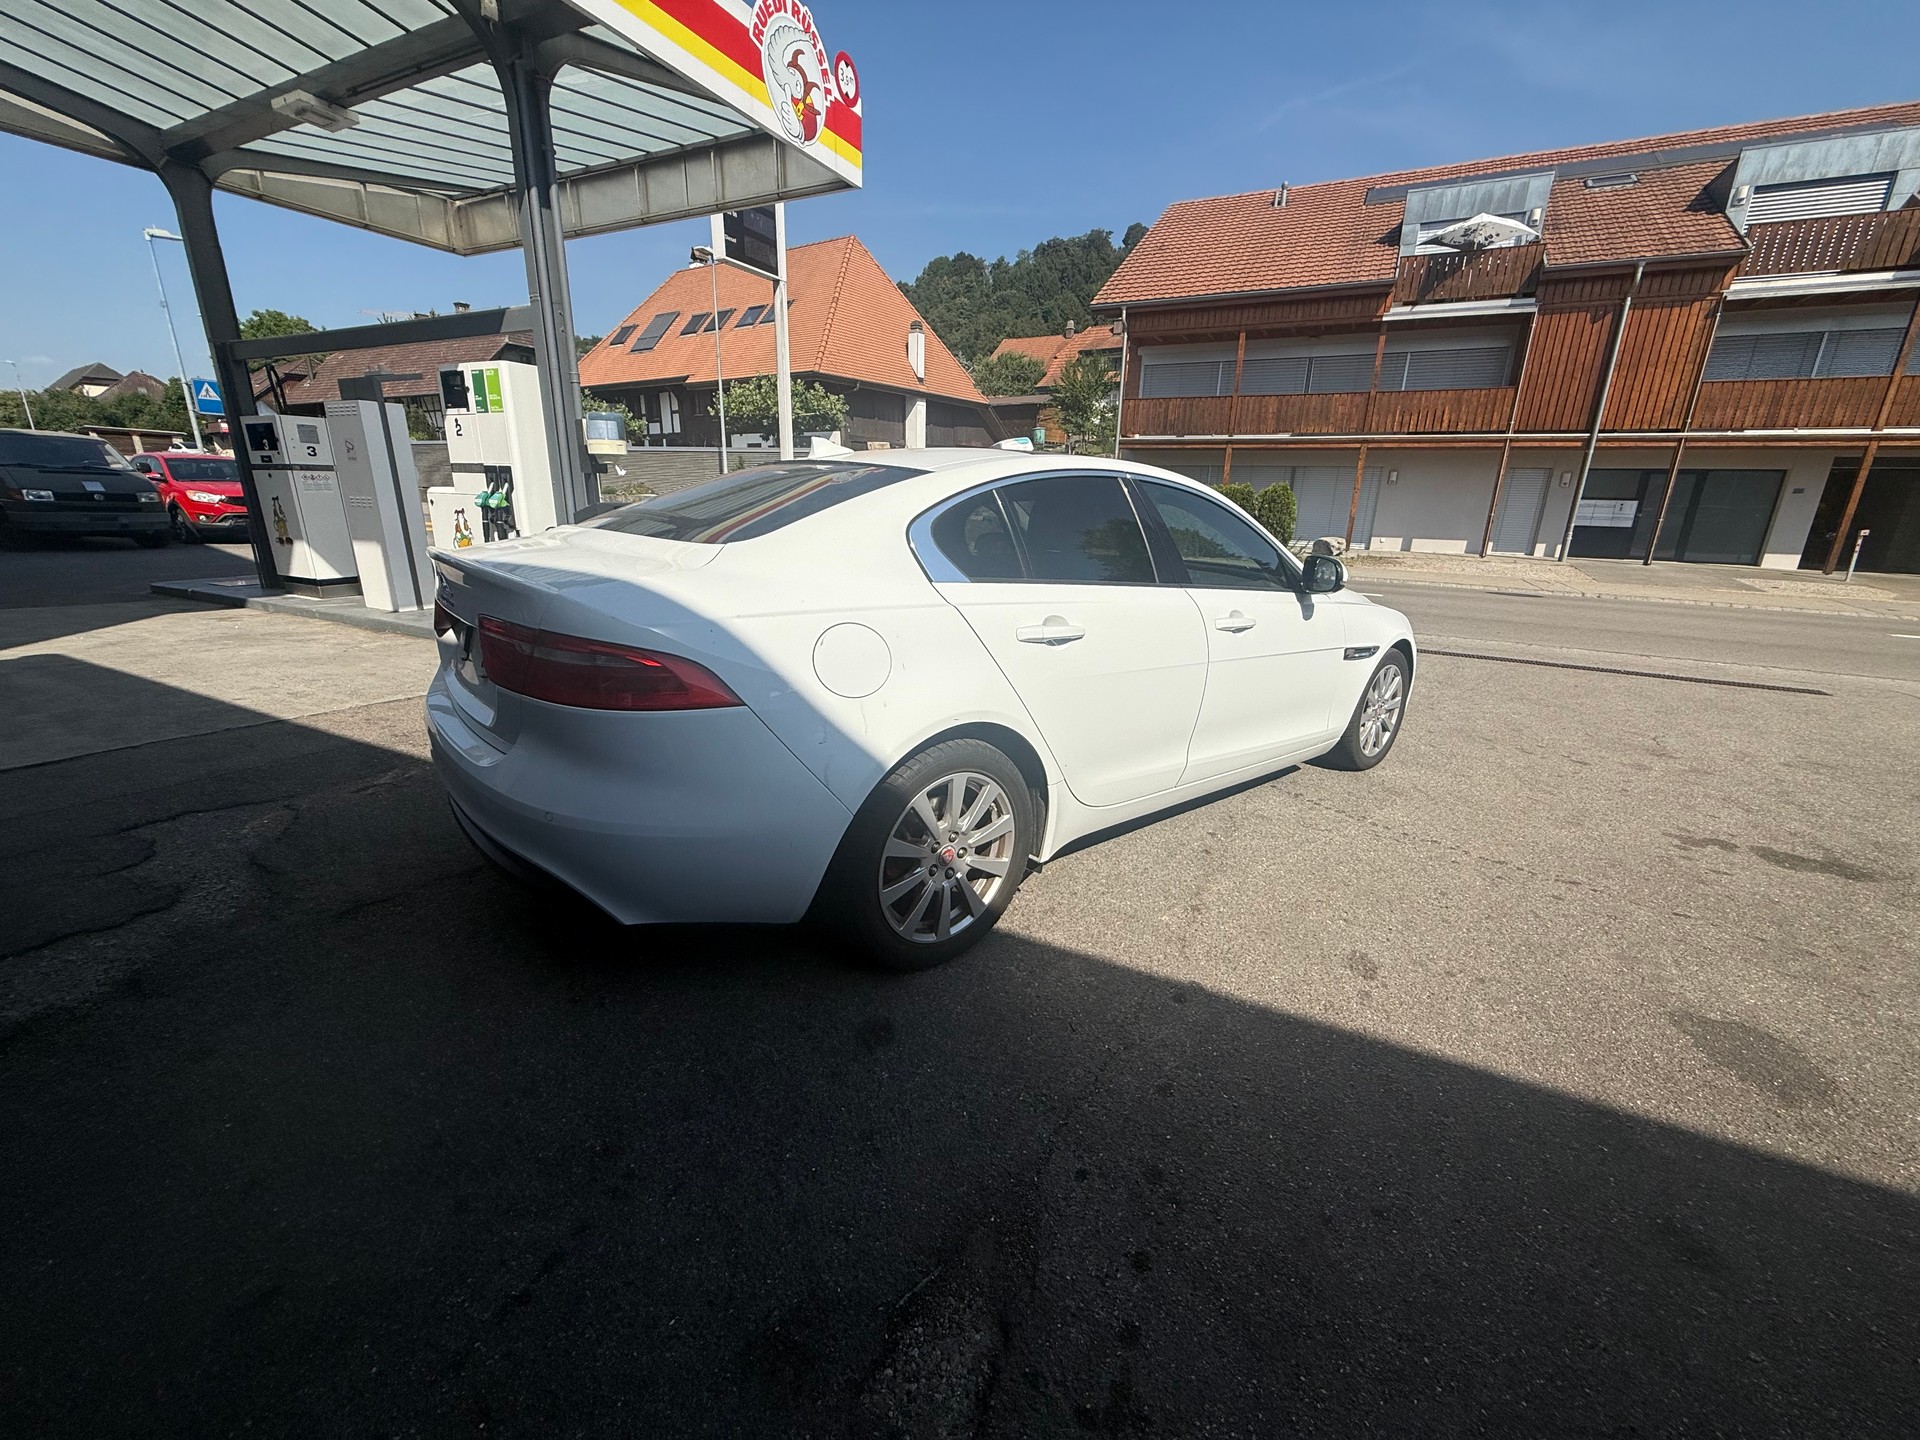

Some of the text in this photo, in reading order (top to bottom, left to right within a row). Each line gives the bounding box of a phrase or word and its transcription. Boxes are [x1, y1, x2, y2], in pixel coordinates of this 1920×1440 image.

[753, 0, 832, 101] RUEDI RÜSSEL
[455, 423, 463, 437] 2
[262, 439, 269, 451] 3
[306, 446, 318, 457] 3
